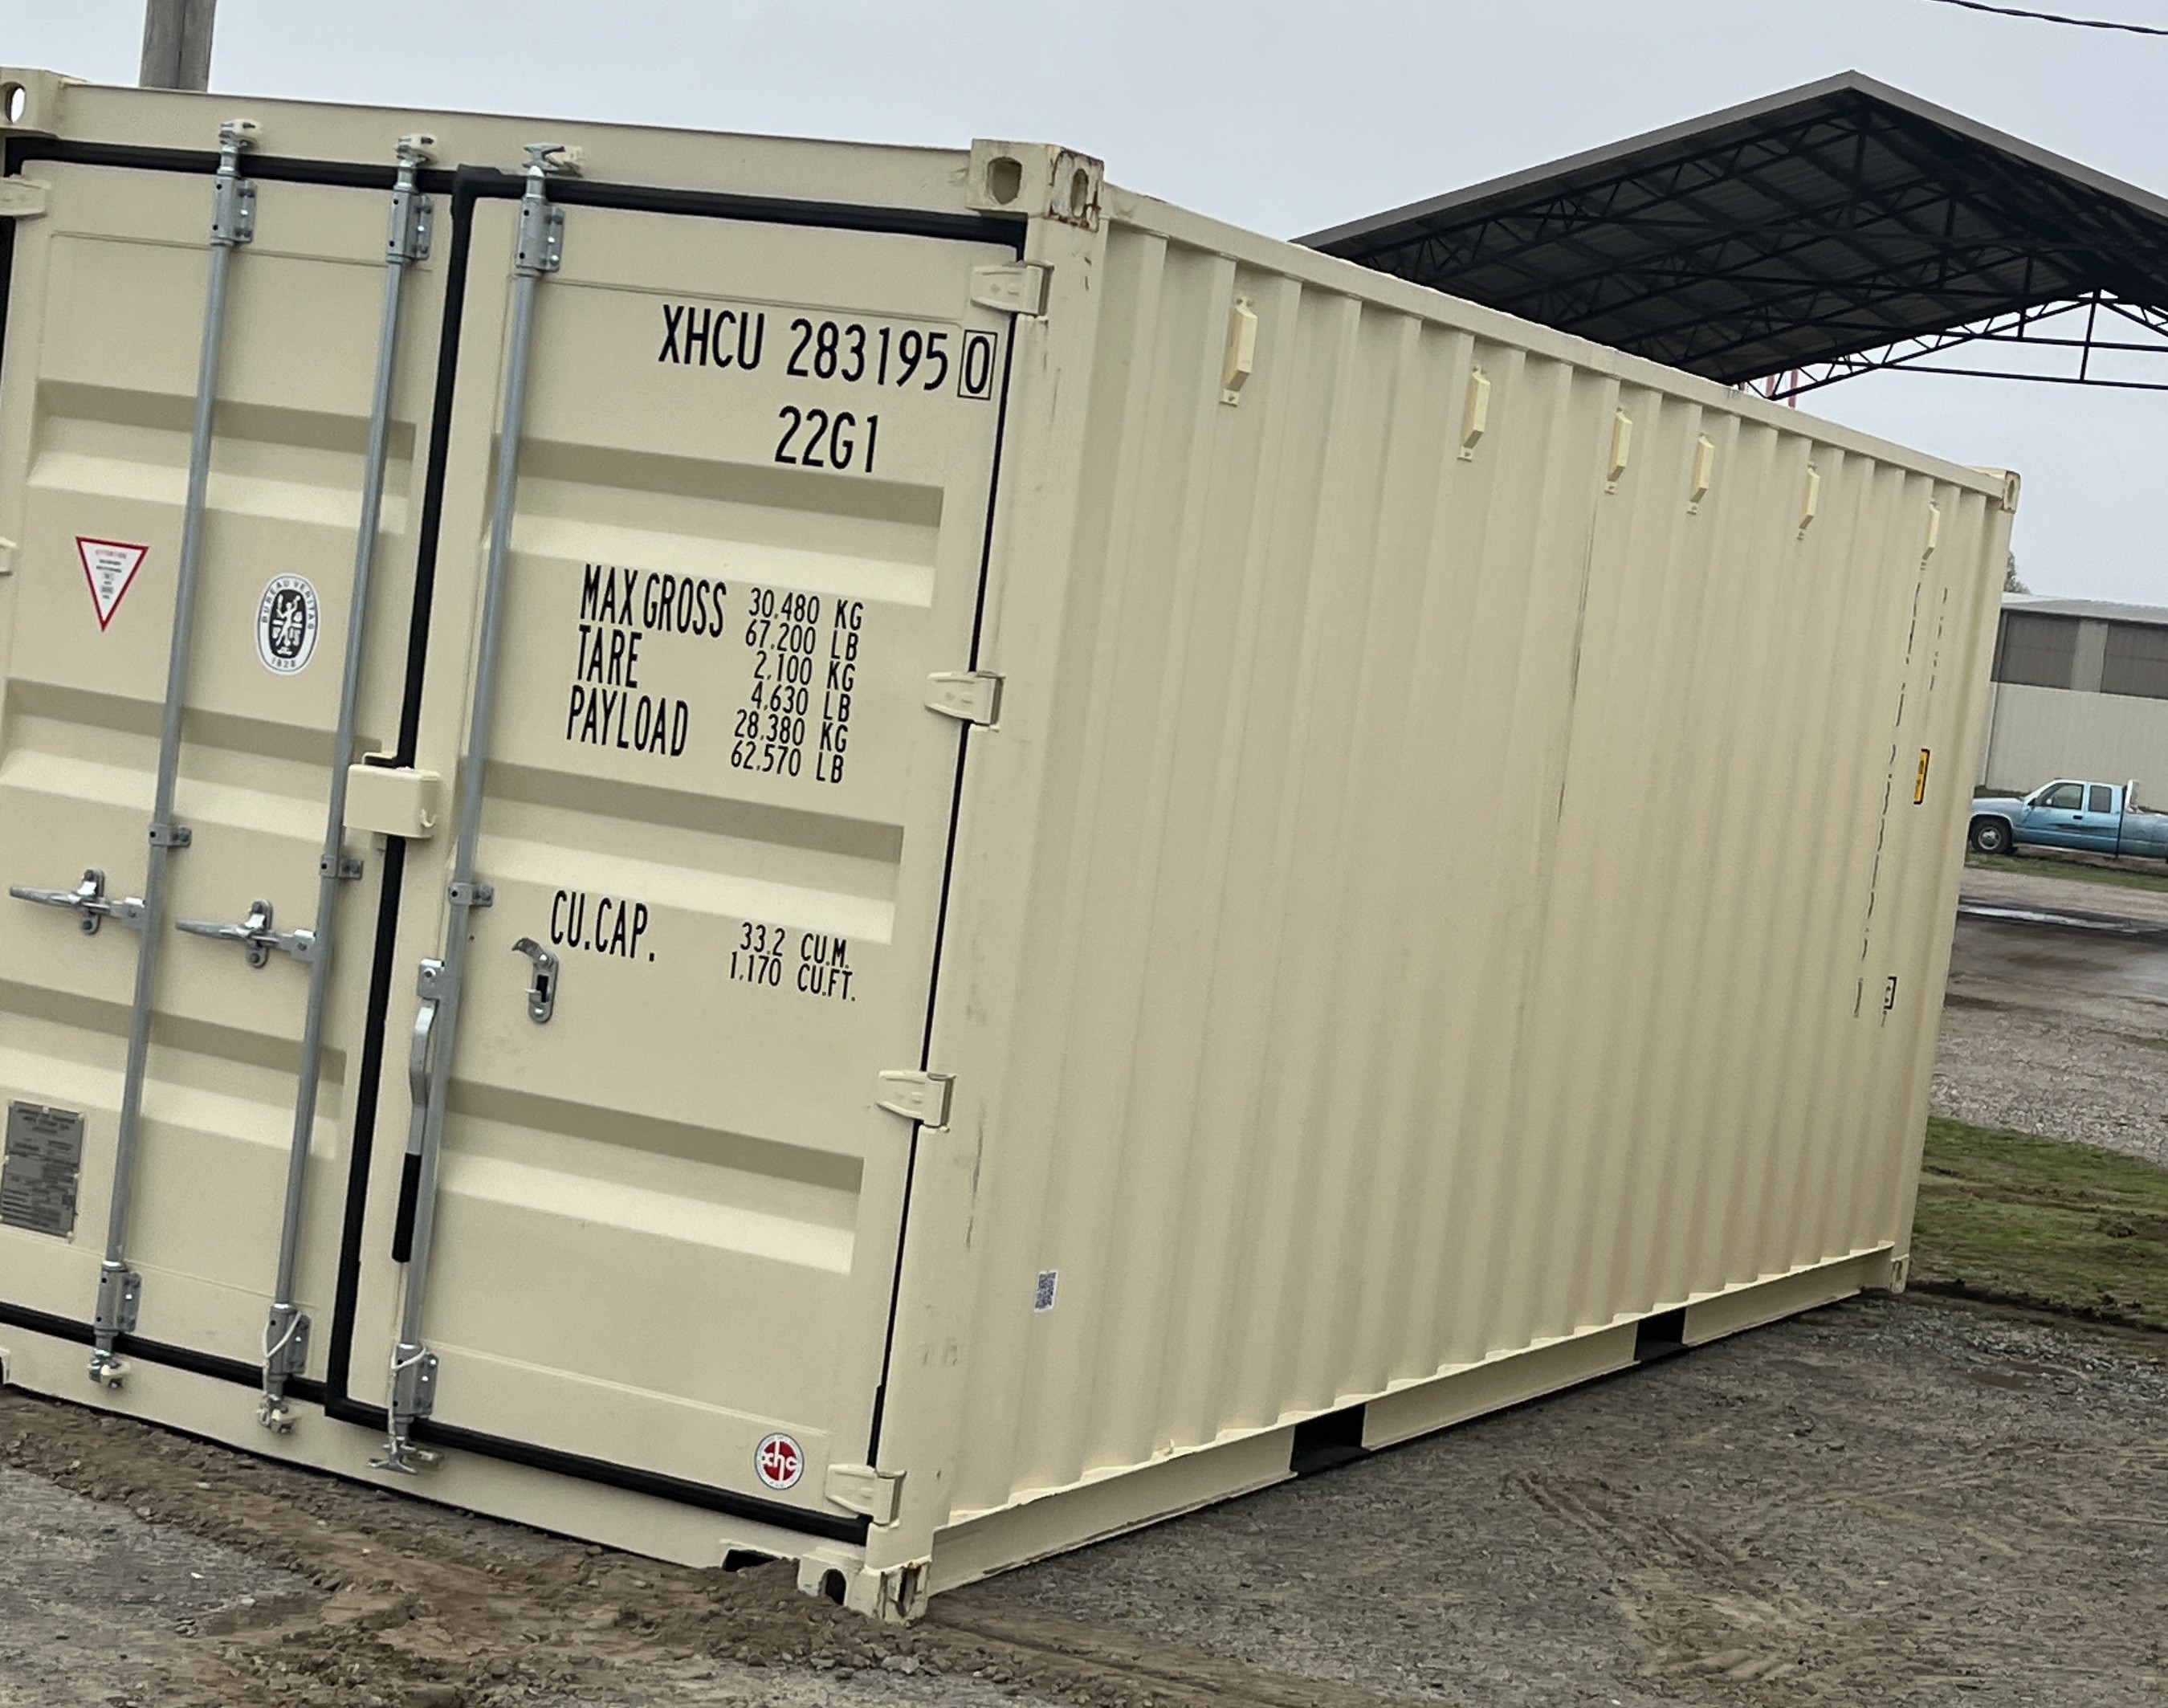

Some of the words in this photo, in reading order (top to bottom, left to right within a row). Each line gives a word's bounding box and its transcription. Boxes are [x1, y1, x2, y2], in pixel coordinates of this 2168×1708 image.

[658, 304, 765, 371] XHCU
[786, 318, 948, 391] 283195
[774, 406, 878, 473] 22G1
[580, 563, 638, 626] MAX
[643, 573, 727, 638] GROSS
[834, 598, 864, 631] KG
[577, 624, 643, 689] TARE
[826, 660, 856, 692] KG
[830, 630, 859, 662] LB
[566, 684, 689, 757] PAYLOAD
[819, 721, 849, 753] KG
[823, 691, 851, 723] LB
[815, 751, 844, 784] LB
